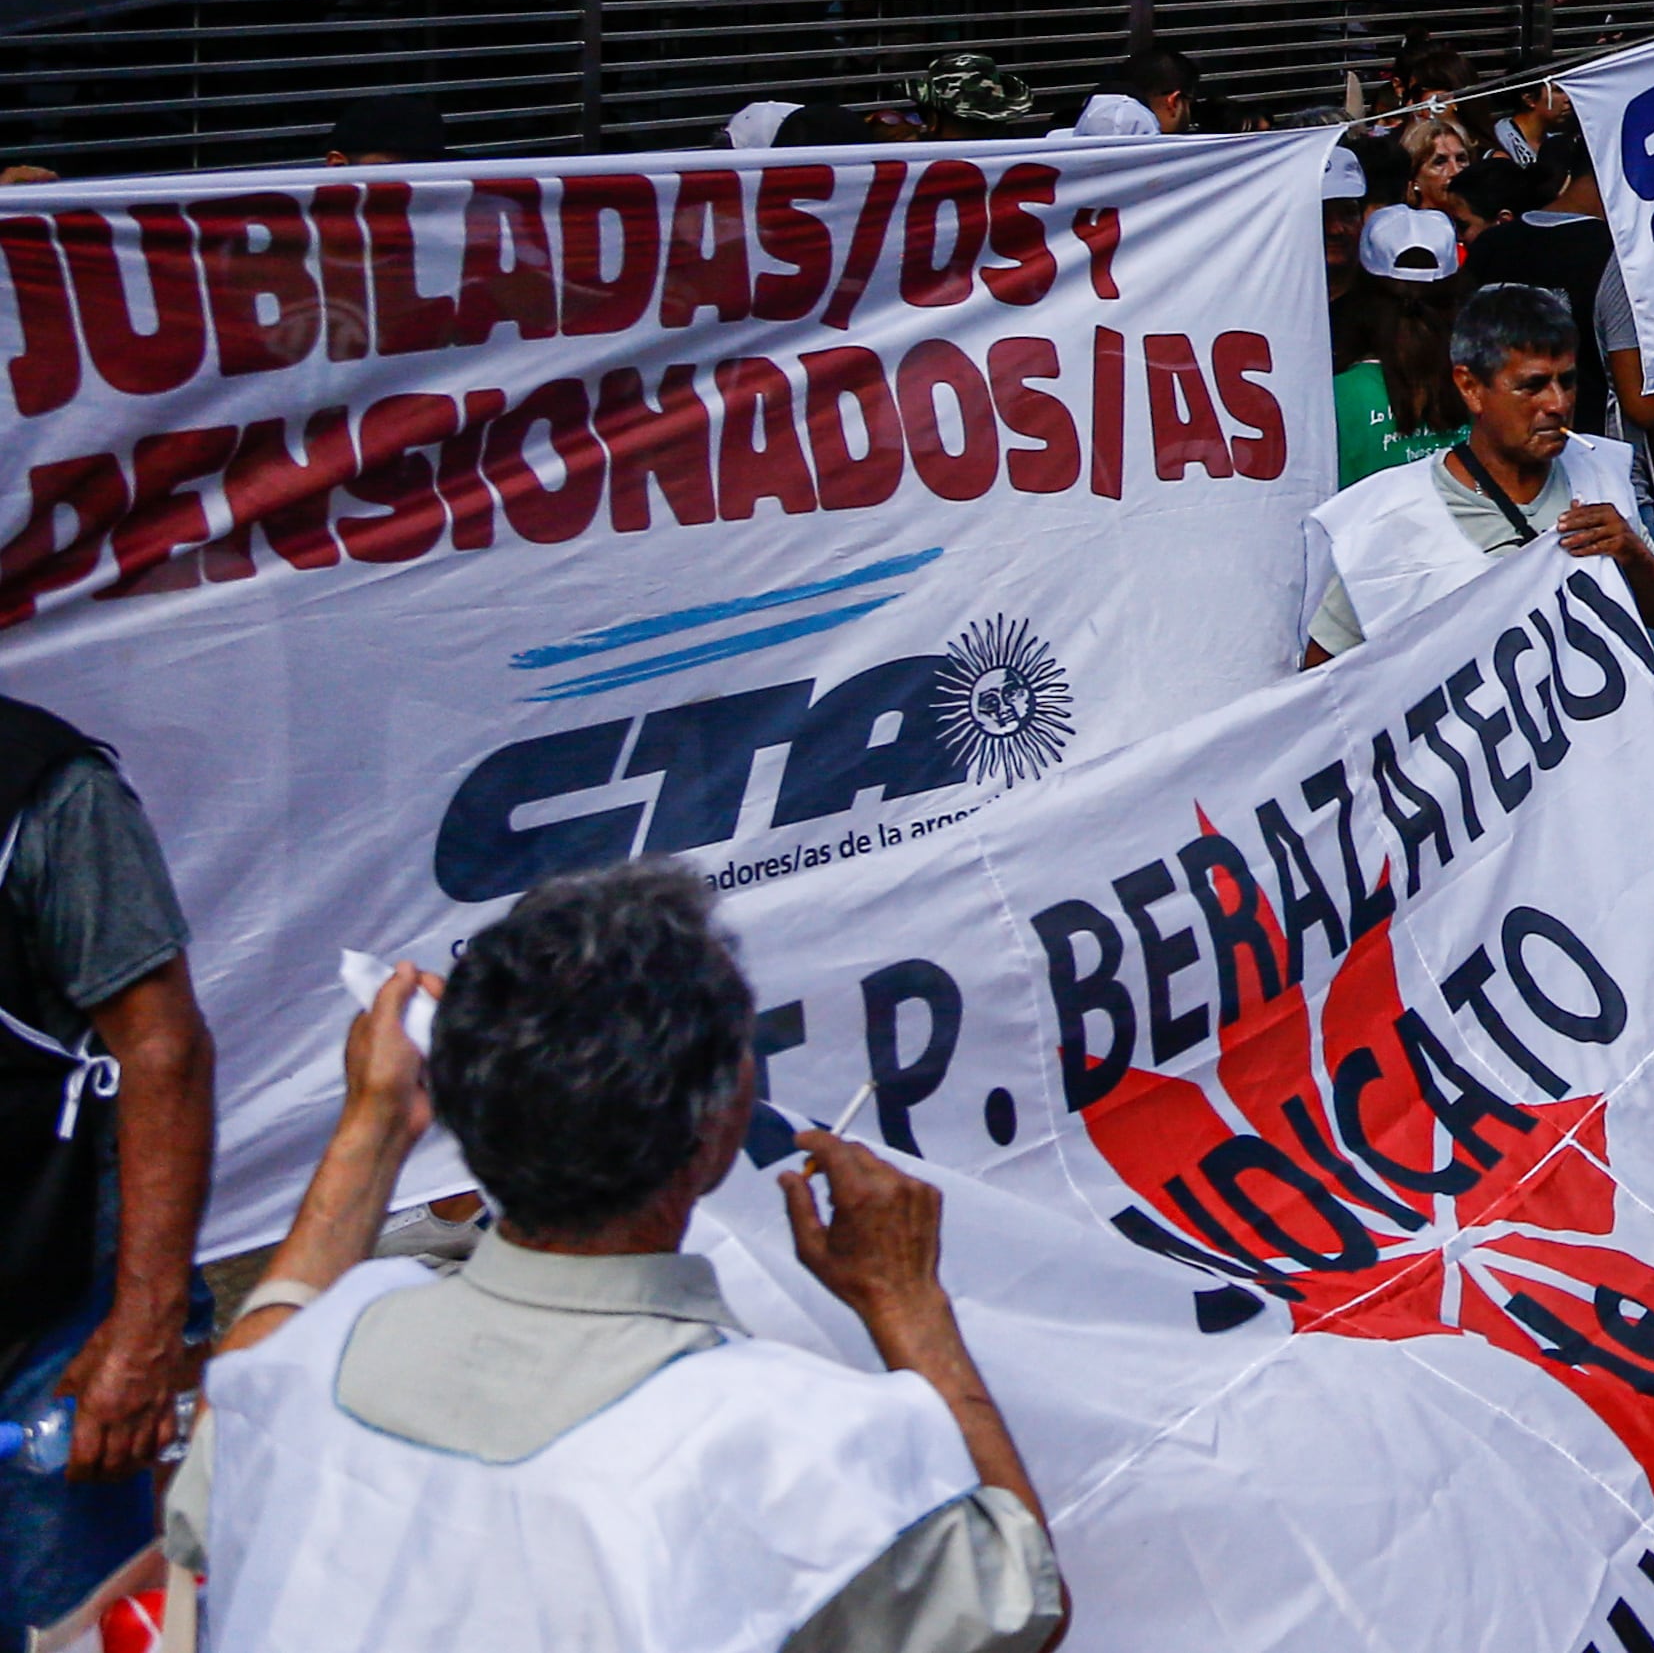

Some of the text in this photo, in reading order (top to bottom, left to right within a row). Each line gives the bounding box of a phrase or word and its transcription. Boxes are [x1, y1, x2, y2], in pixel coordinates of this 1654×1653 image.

[0, 158, 1063, 419] JUBILADAS/OS
[0, 325, 1287, 630] PENSIONADOS/AS
[434, 654, 970, 904] CTA
[838, 830, 871, 859] de
[879, 822, 902, 849] la
